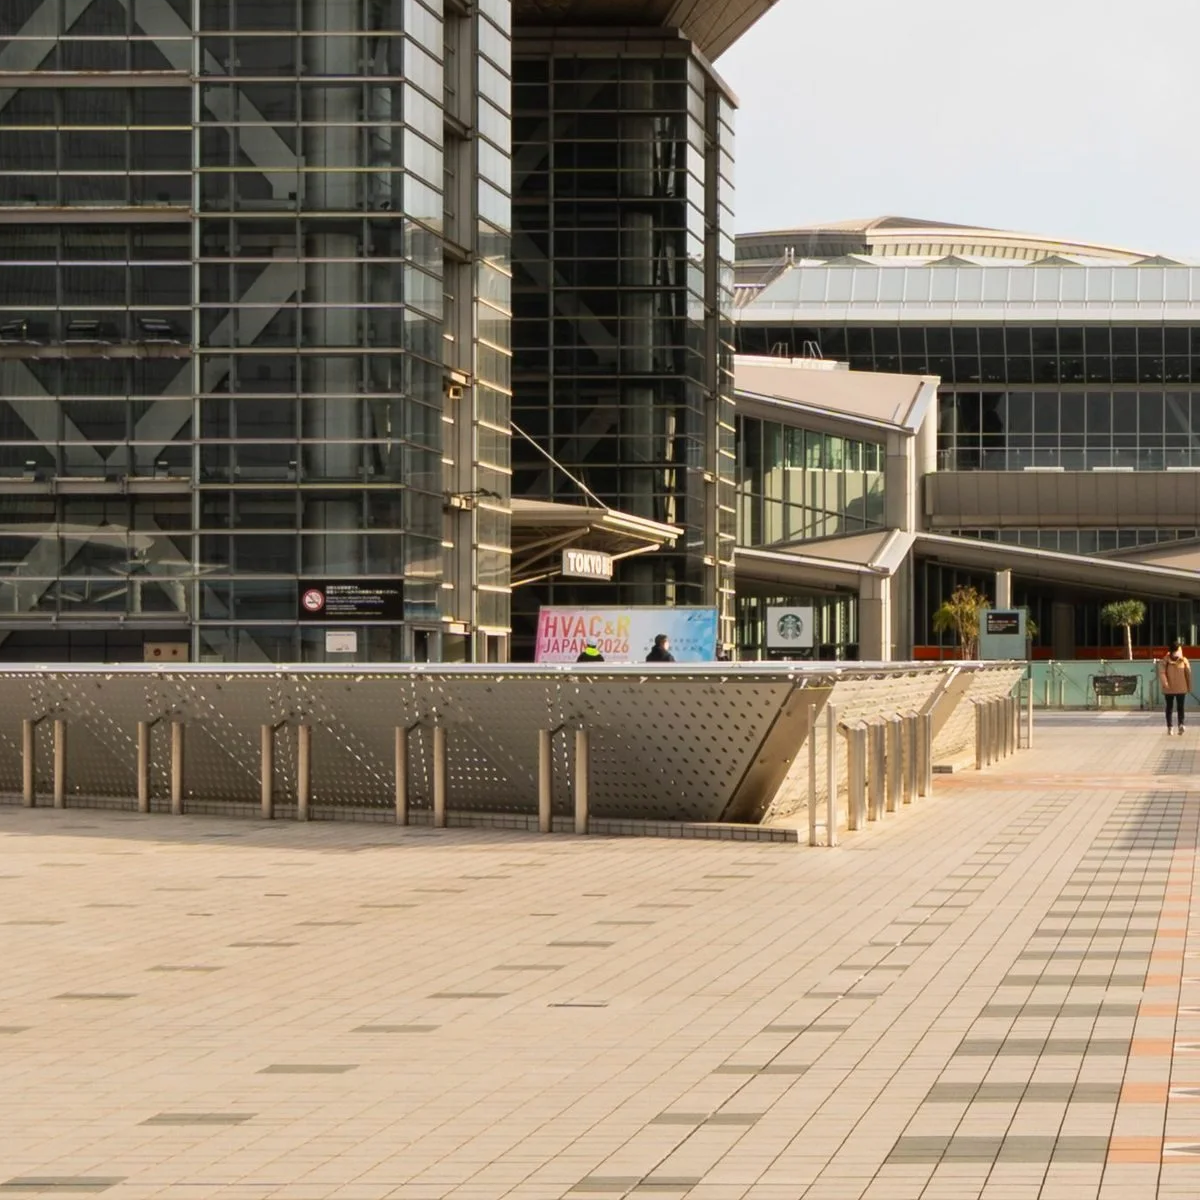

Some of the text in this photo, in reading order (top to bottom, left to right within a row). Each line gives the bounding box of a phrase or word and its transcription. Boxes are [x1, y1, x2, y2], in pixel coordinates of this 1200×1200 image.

[568, 552, 602, 575] TOKYO
[544, 615, 630, 637] HVAC&R
[597, 638, 629, 653] 2026
